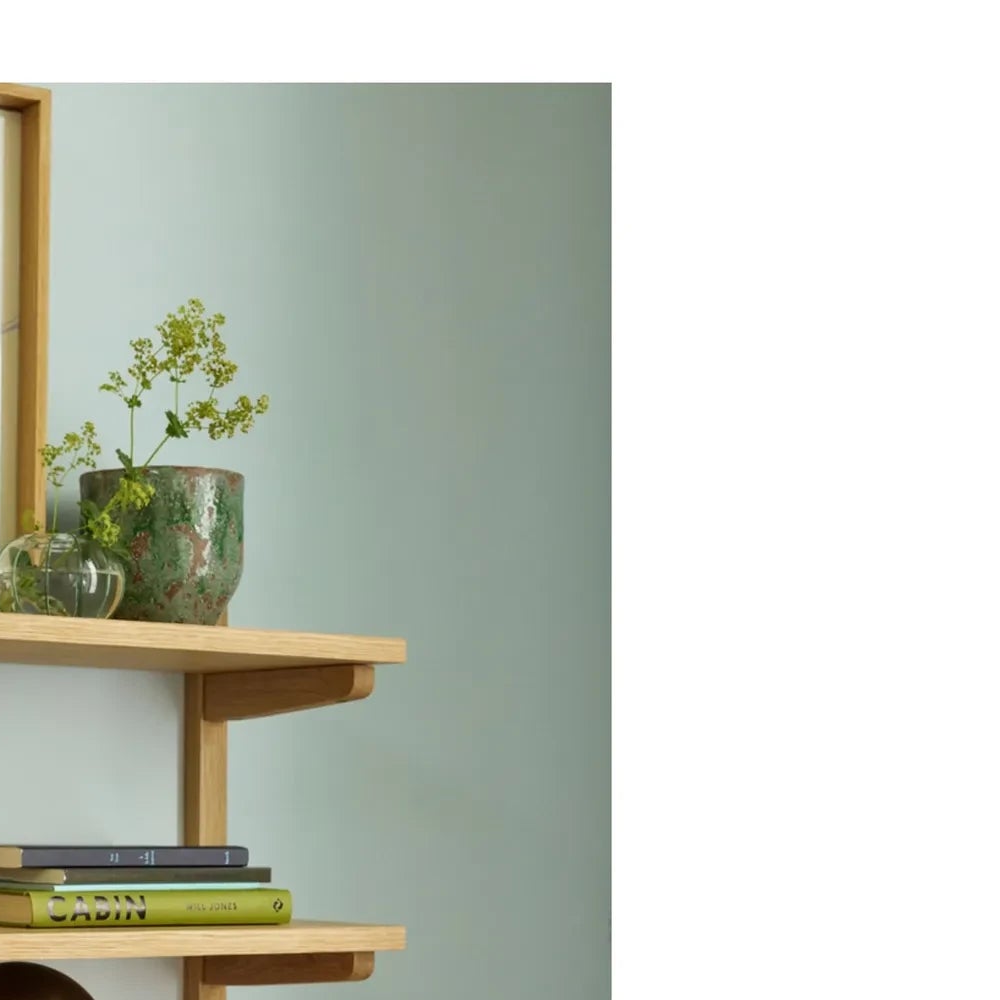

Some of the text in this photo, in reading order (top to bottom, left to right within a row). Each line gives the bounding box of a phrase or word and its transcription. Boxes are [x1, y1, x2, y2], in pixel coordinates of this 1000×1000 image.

[47, 895, 146, 922] CABIN
[186, 901, 237, 911] WILL JONES
